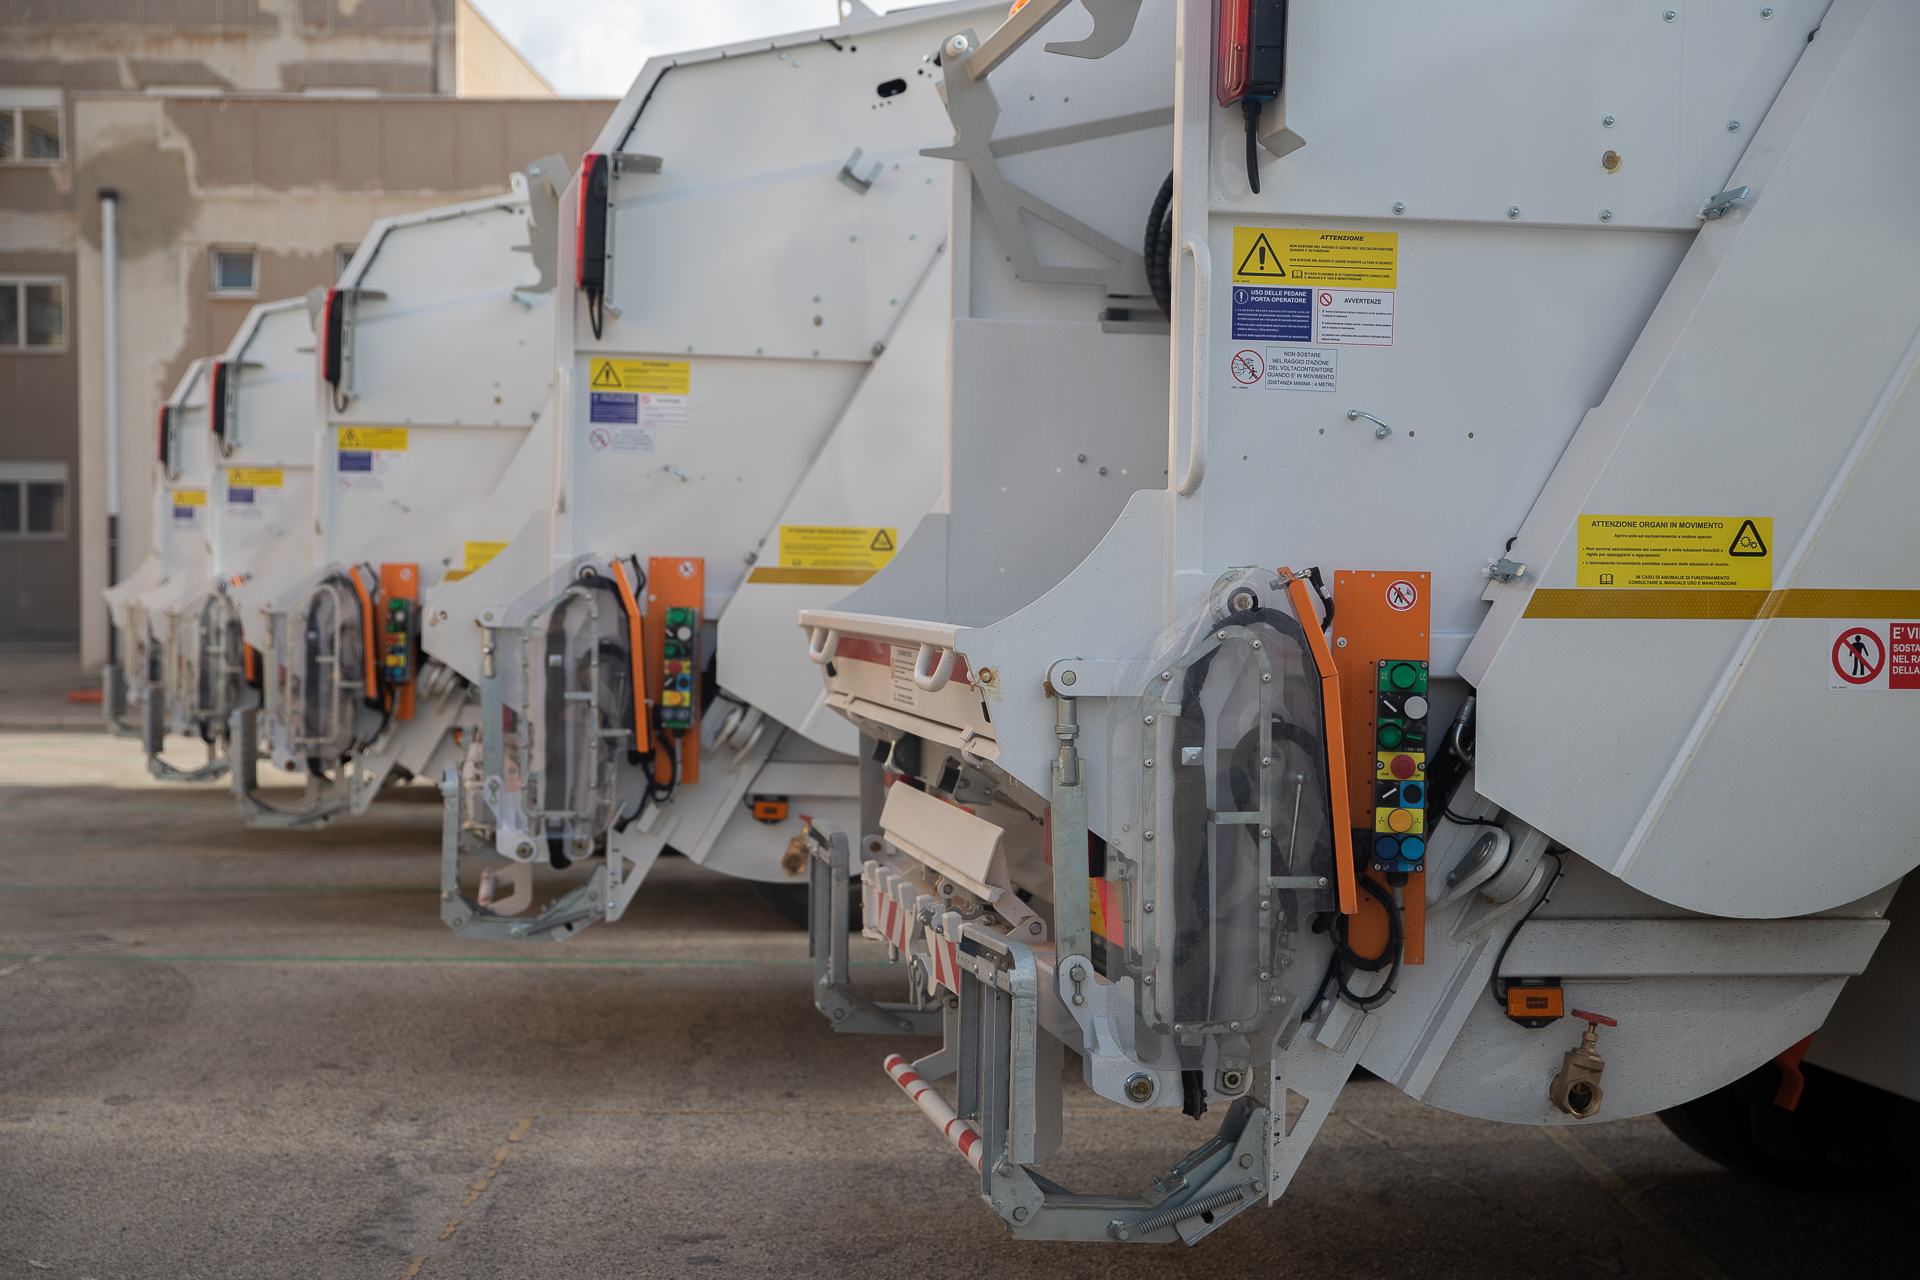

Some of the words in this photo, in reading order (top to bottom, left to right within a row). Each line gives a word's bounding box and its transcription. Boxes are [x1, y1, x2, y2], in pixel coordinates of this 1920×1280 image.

[1907, 627, 1920, 639] VI
[1893, 643, 1920, 652] SOSTA
[1892, 655, 1910, 663] NEL
[1892, 666, 1920, 674] DELLA
